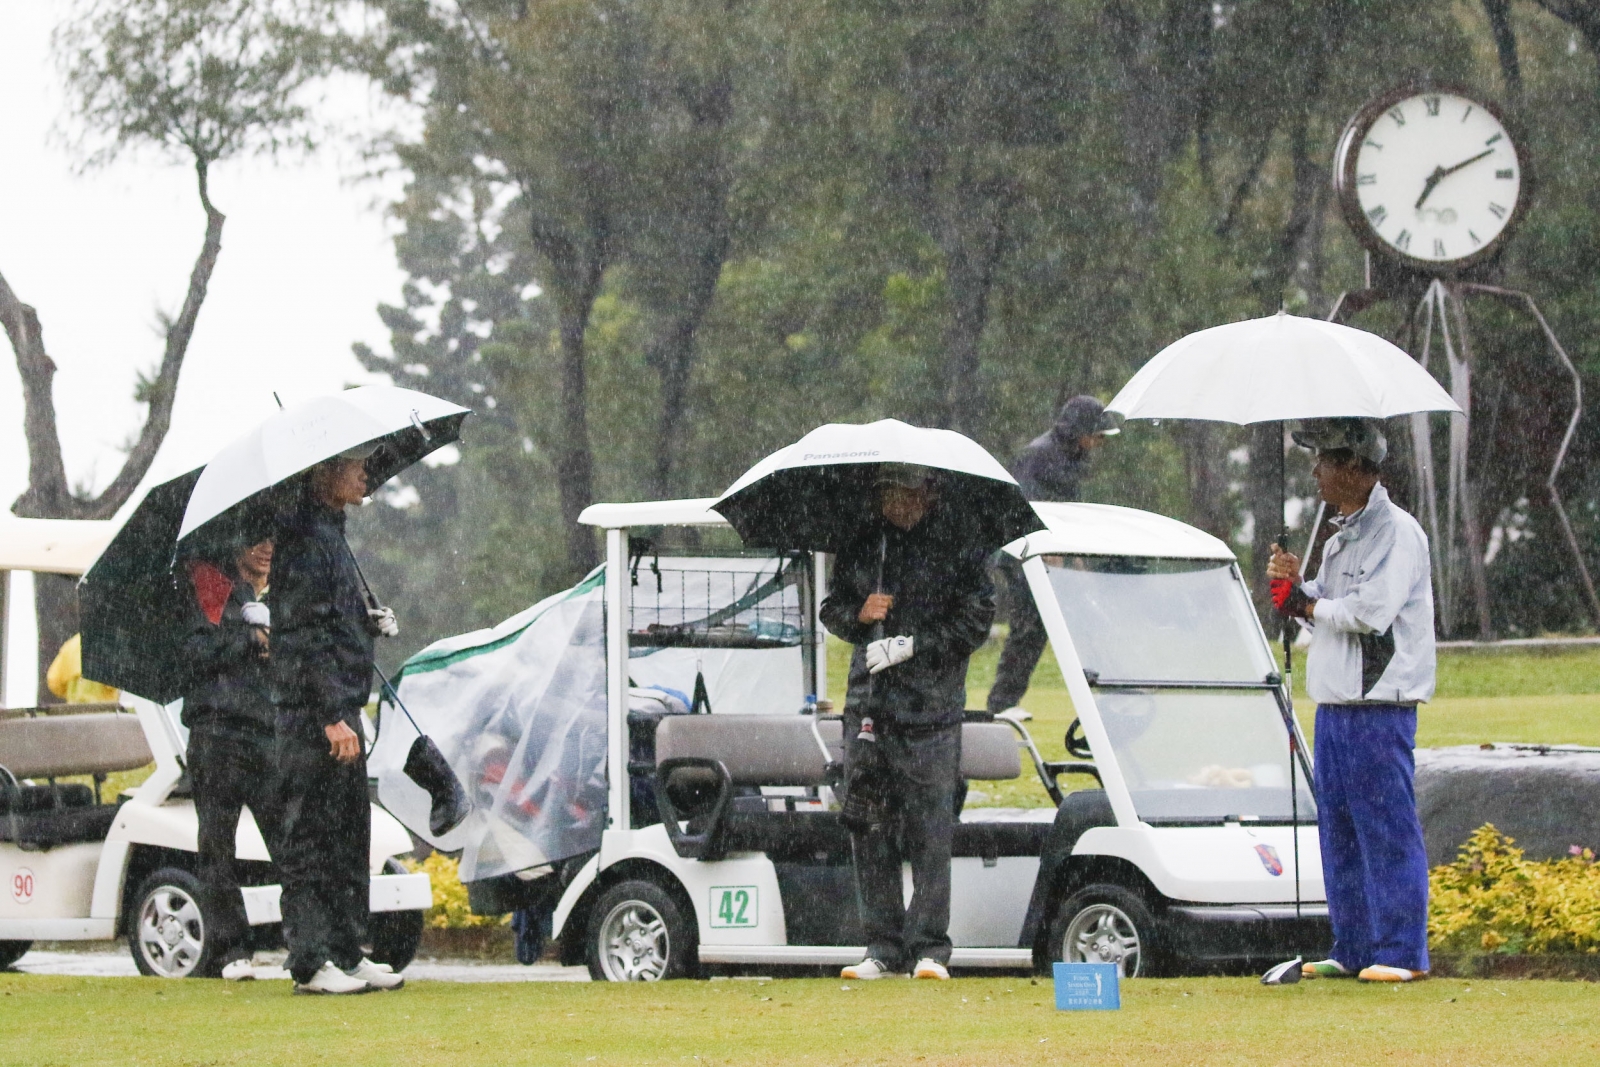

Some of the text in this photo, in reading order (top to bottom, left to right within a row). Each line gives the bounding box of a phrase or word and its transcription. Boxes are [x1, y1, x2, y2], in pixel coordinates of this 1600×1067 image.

[803, 449, 880, 461] Panasonic
[14, 874, 33, 897] 90
[718, 889, 749, 924] 42
